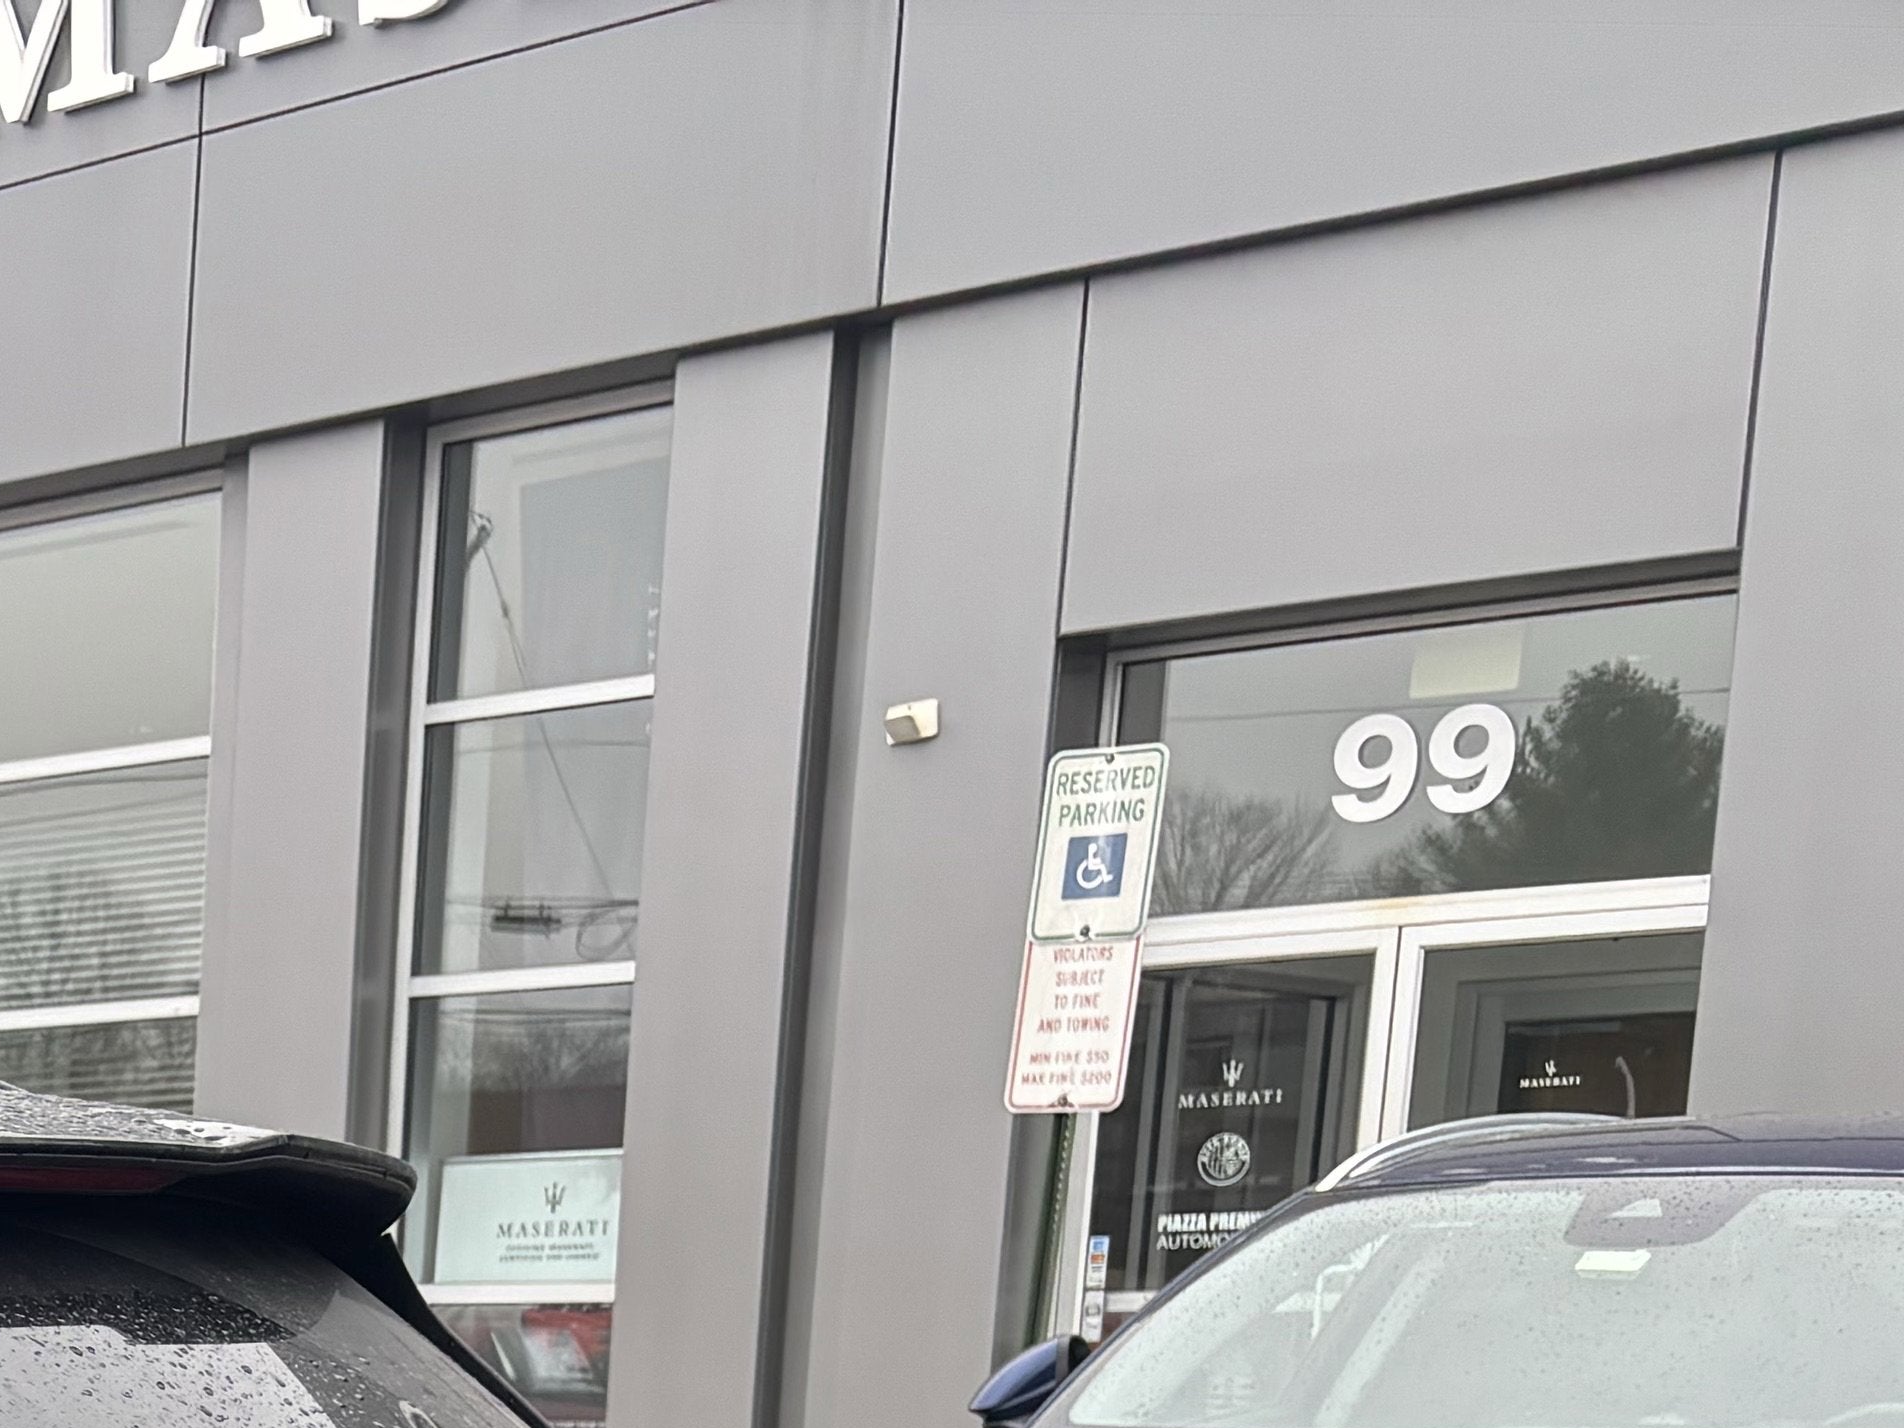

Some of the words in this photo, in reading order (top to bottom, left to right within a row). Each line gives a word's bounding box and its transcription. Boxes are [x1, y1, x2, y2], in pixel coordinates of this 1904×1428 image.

[1331, 703, 1516, 823] 99
[1056, 765, 1156, 797] RESERVED
[1058, 798, 1145, 828] PARKING
[1053, 946, 1114, 963] VIOLATORS
[1055, 968, 1105, 988] SUBJECT
[1054, 993, 1067, 1010] TO
[1072, 992, 1101, 1010] FINE
[1037, 1017, 1062, 1034] AND
[1067, 1015, 1111, 1034] TOWING
[1178, 1088, 1283, 1109] MASERATI
[496, 1219, 609, 1239] MASERATI
[1157, 1212, 1207, 1233] PIAZZA
